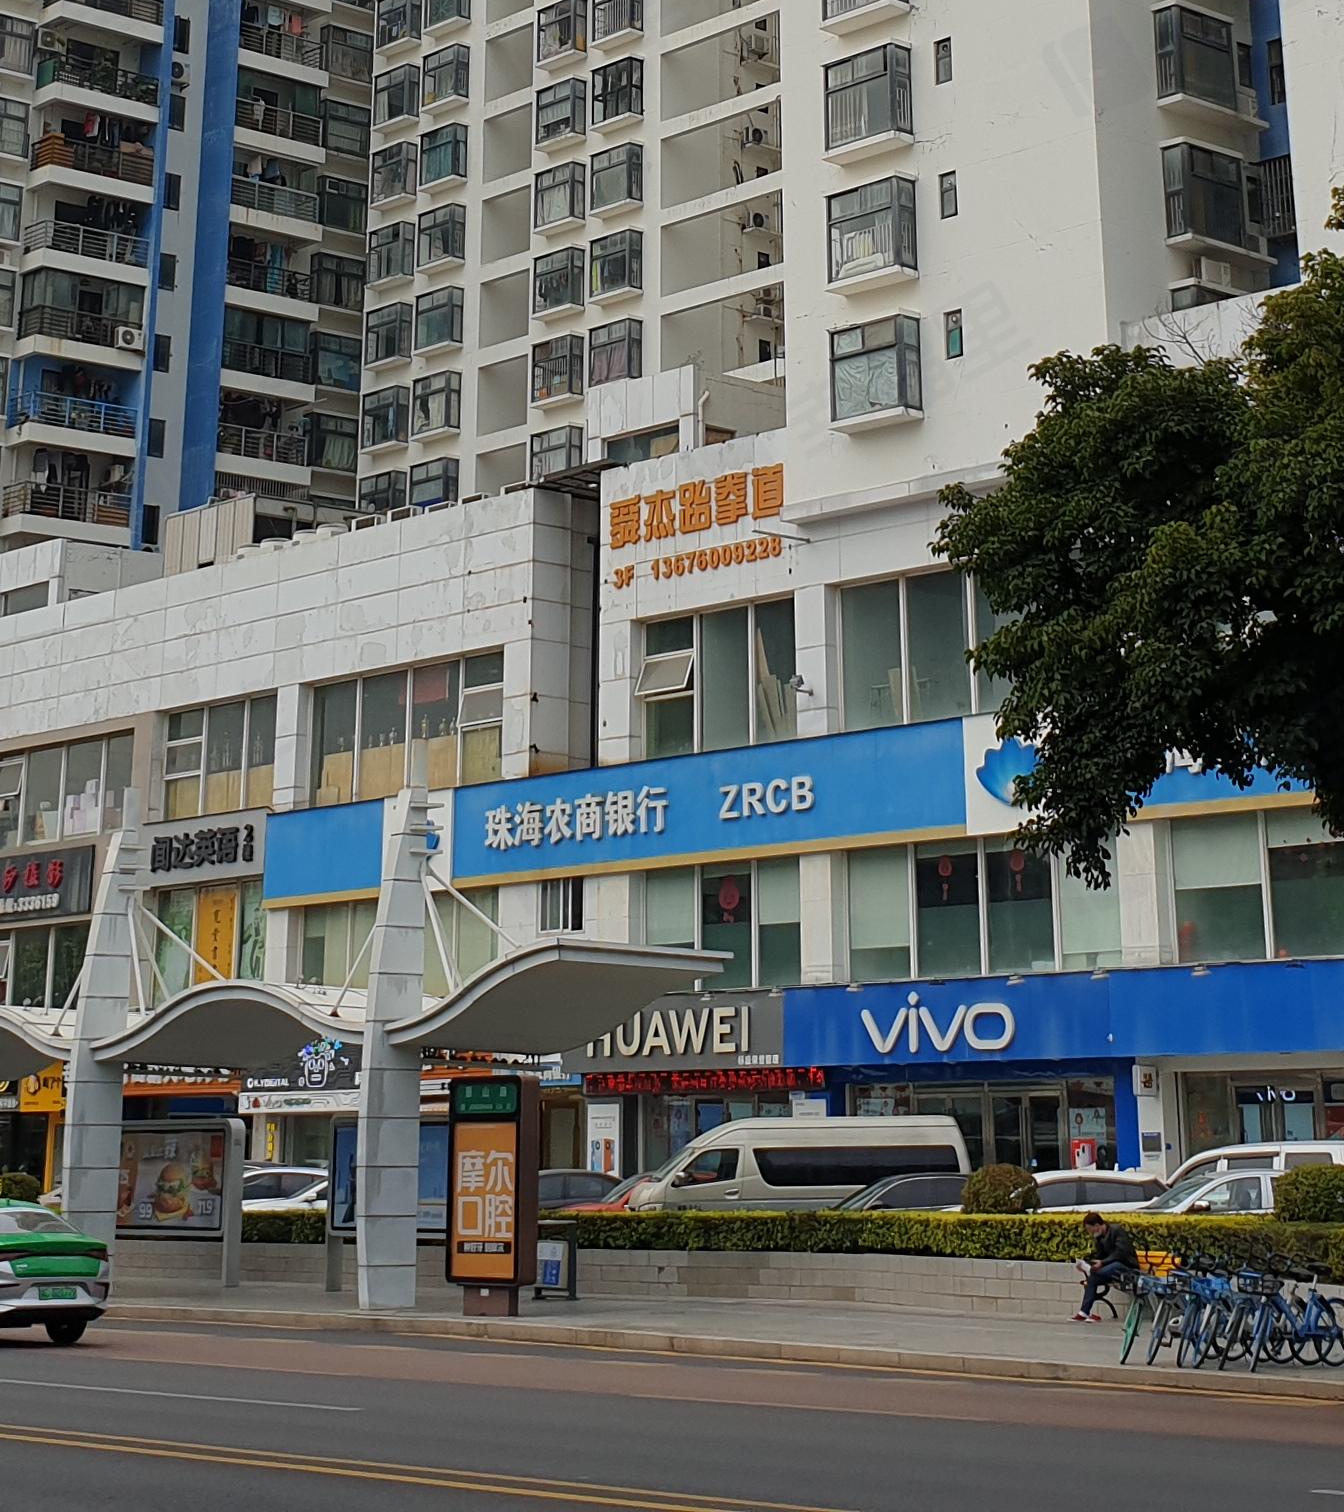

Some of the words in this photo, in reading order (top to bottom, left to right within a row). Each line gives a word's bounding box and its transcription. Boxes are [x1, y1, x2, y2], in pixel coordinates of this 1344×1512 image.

[608, 463, 785, 550] 舜杰跆拳道
[612, 563, 635, 590] 3F
[650, 536, 783, 580] 13676009228
[483, 785, 668, 851] 珠海农商银行
[718, 775, 815, 821] ZRCB
[860, 991, 1016, 1054] vivo
[457, 1149, 514, 1192] 摩尔
[457, 1194, 513, 1238] 口腔
